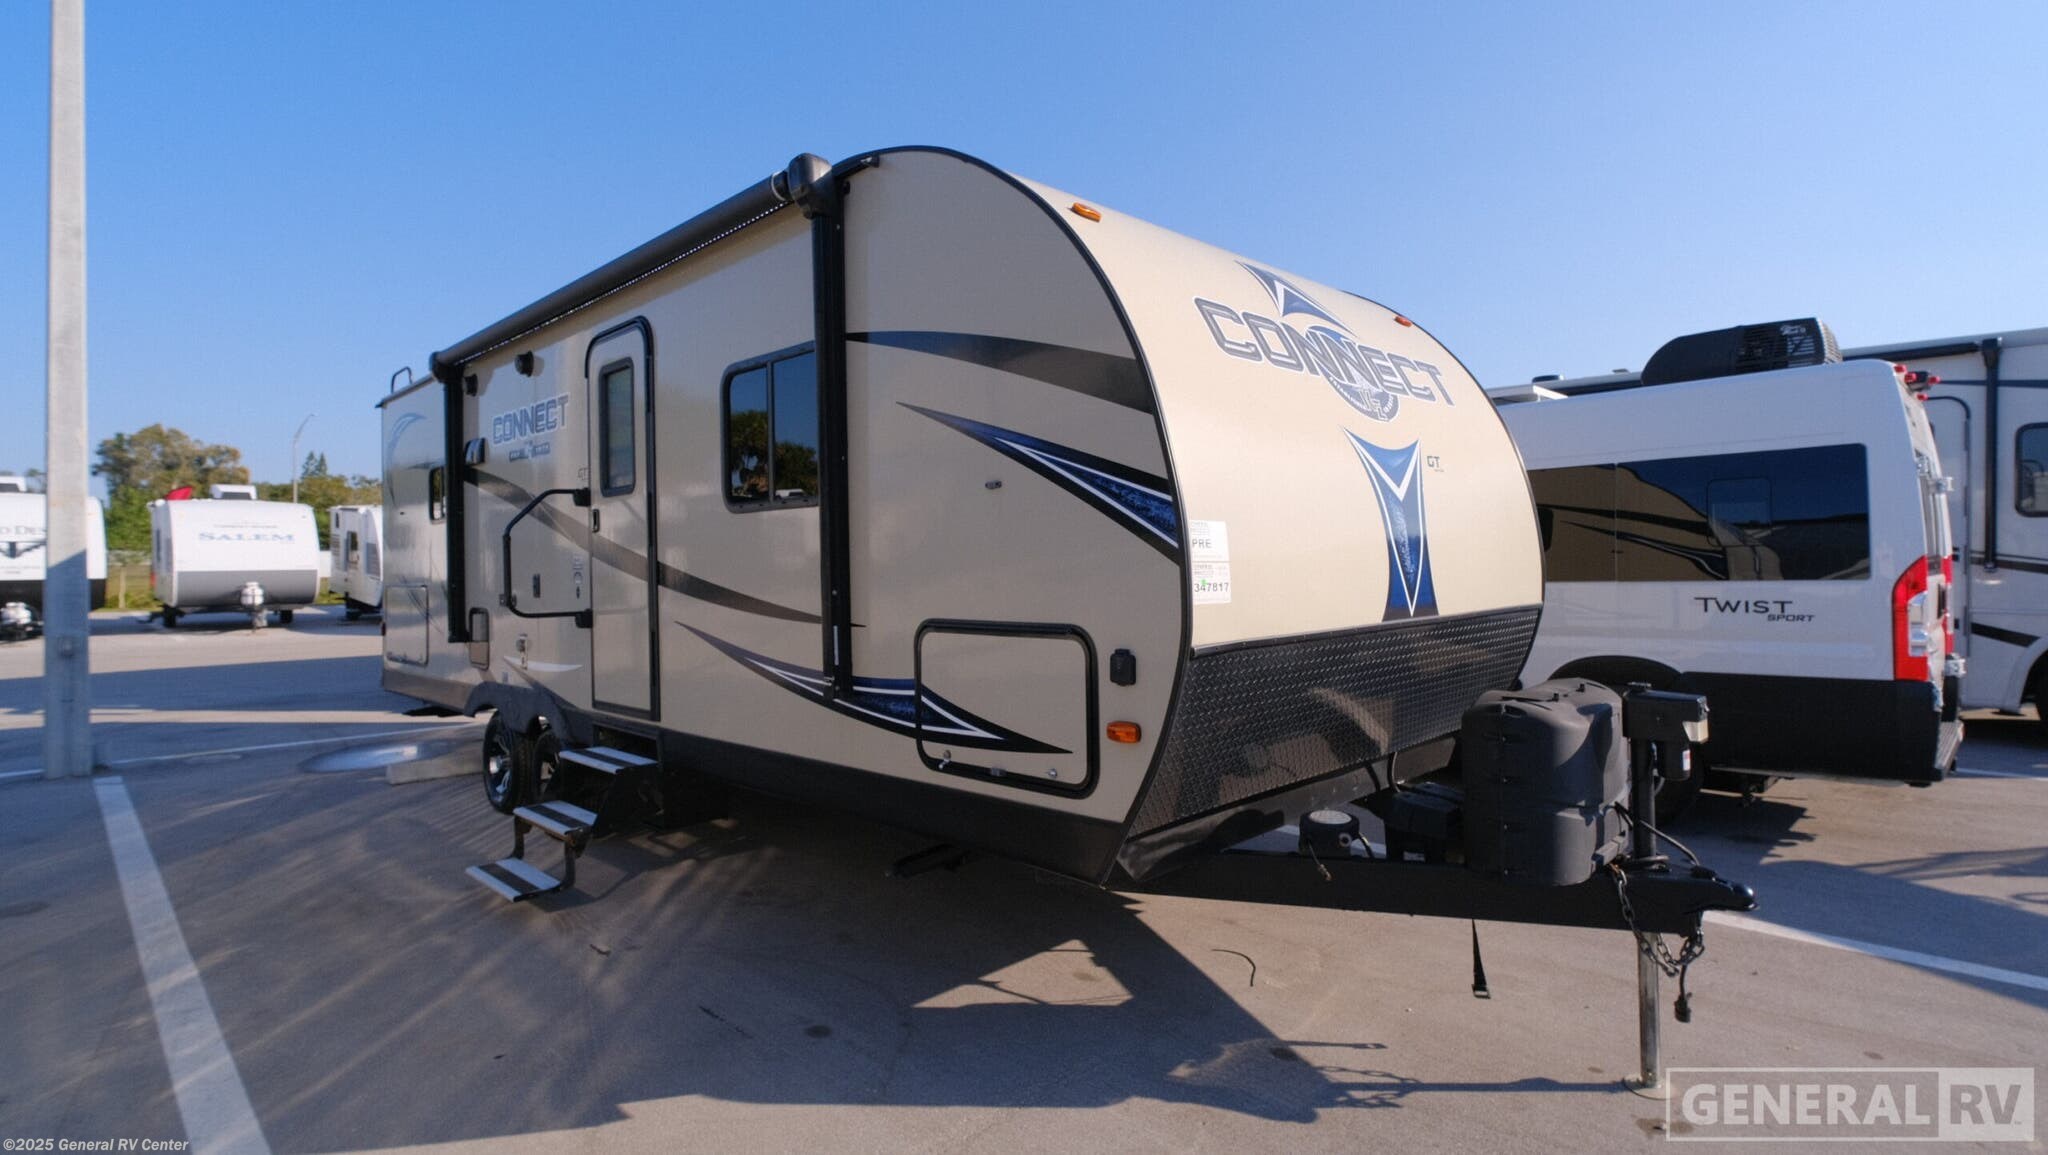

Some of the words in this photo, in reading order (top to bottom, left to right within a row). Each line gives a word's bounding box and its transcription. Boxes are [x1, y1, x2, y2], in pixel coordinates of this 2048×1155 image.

[1194, 296, 1455, 406] CONNECT
[492, 393, 569, 445] CONNECT
[1426, 455, 1440, 468] GT
[199, 532, 295, 542] SALEM
[1192, 538, 1213, 549] PRE
[1694, 597, 1792, 614] TWIST
[1767, 613, 1815, 622] SPORT
